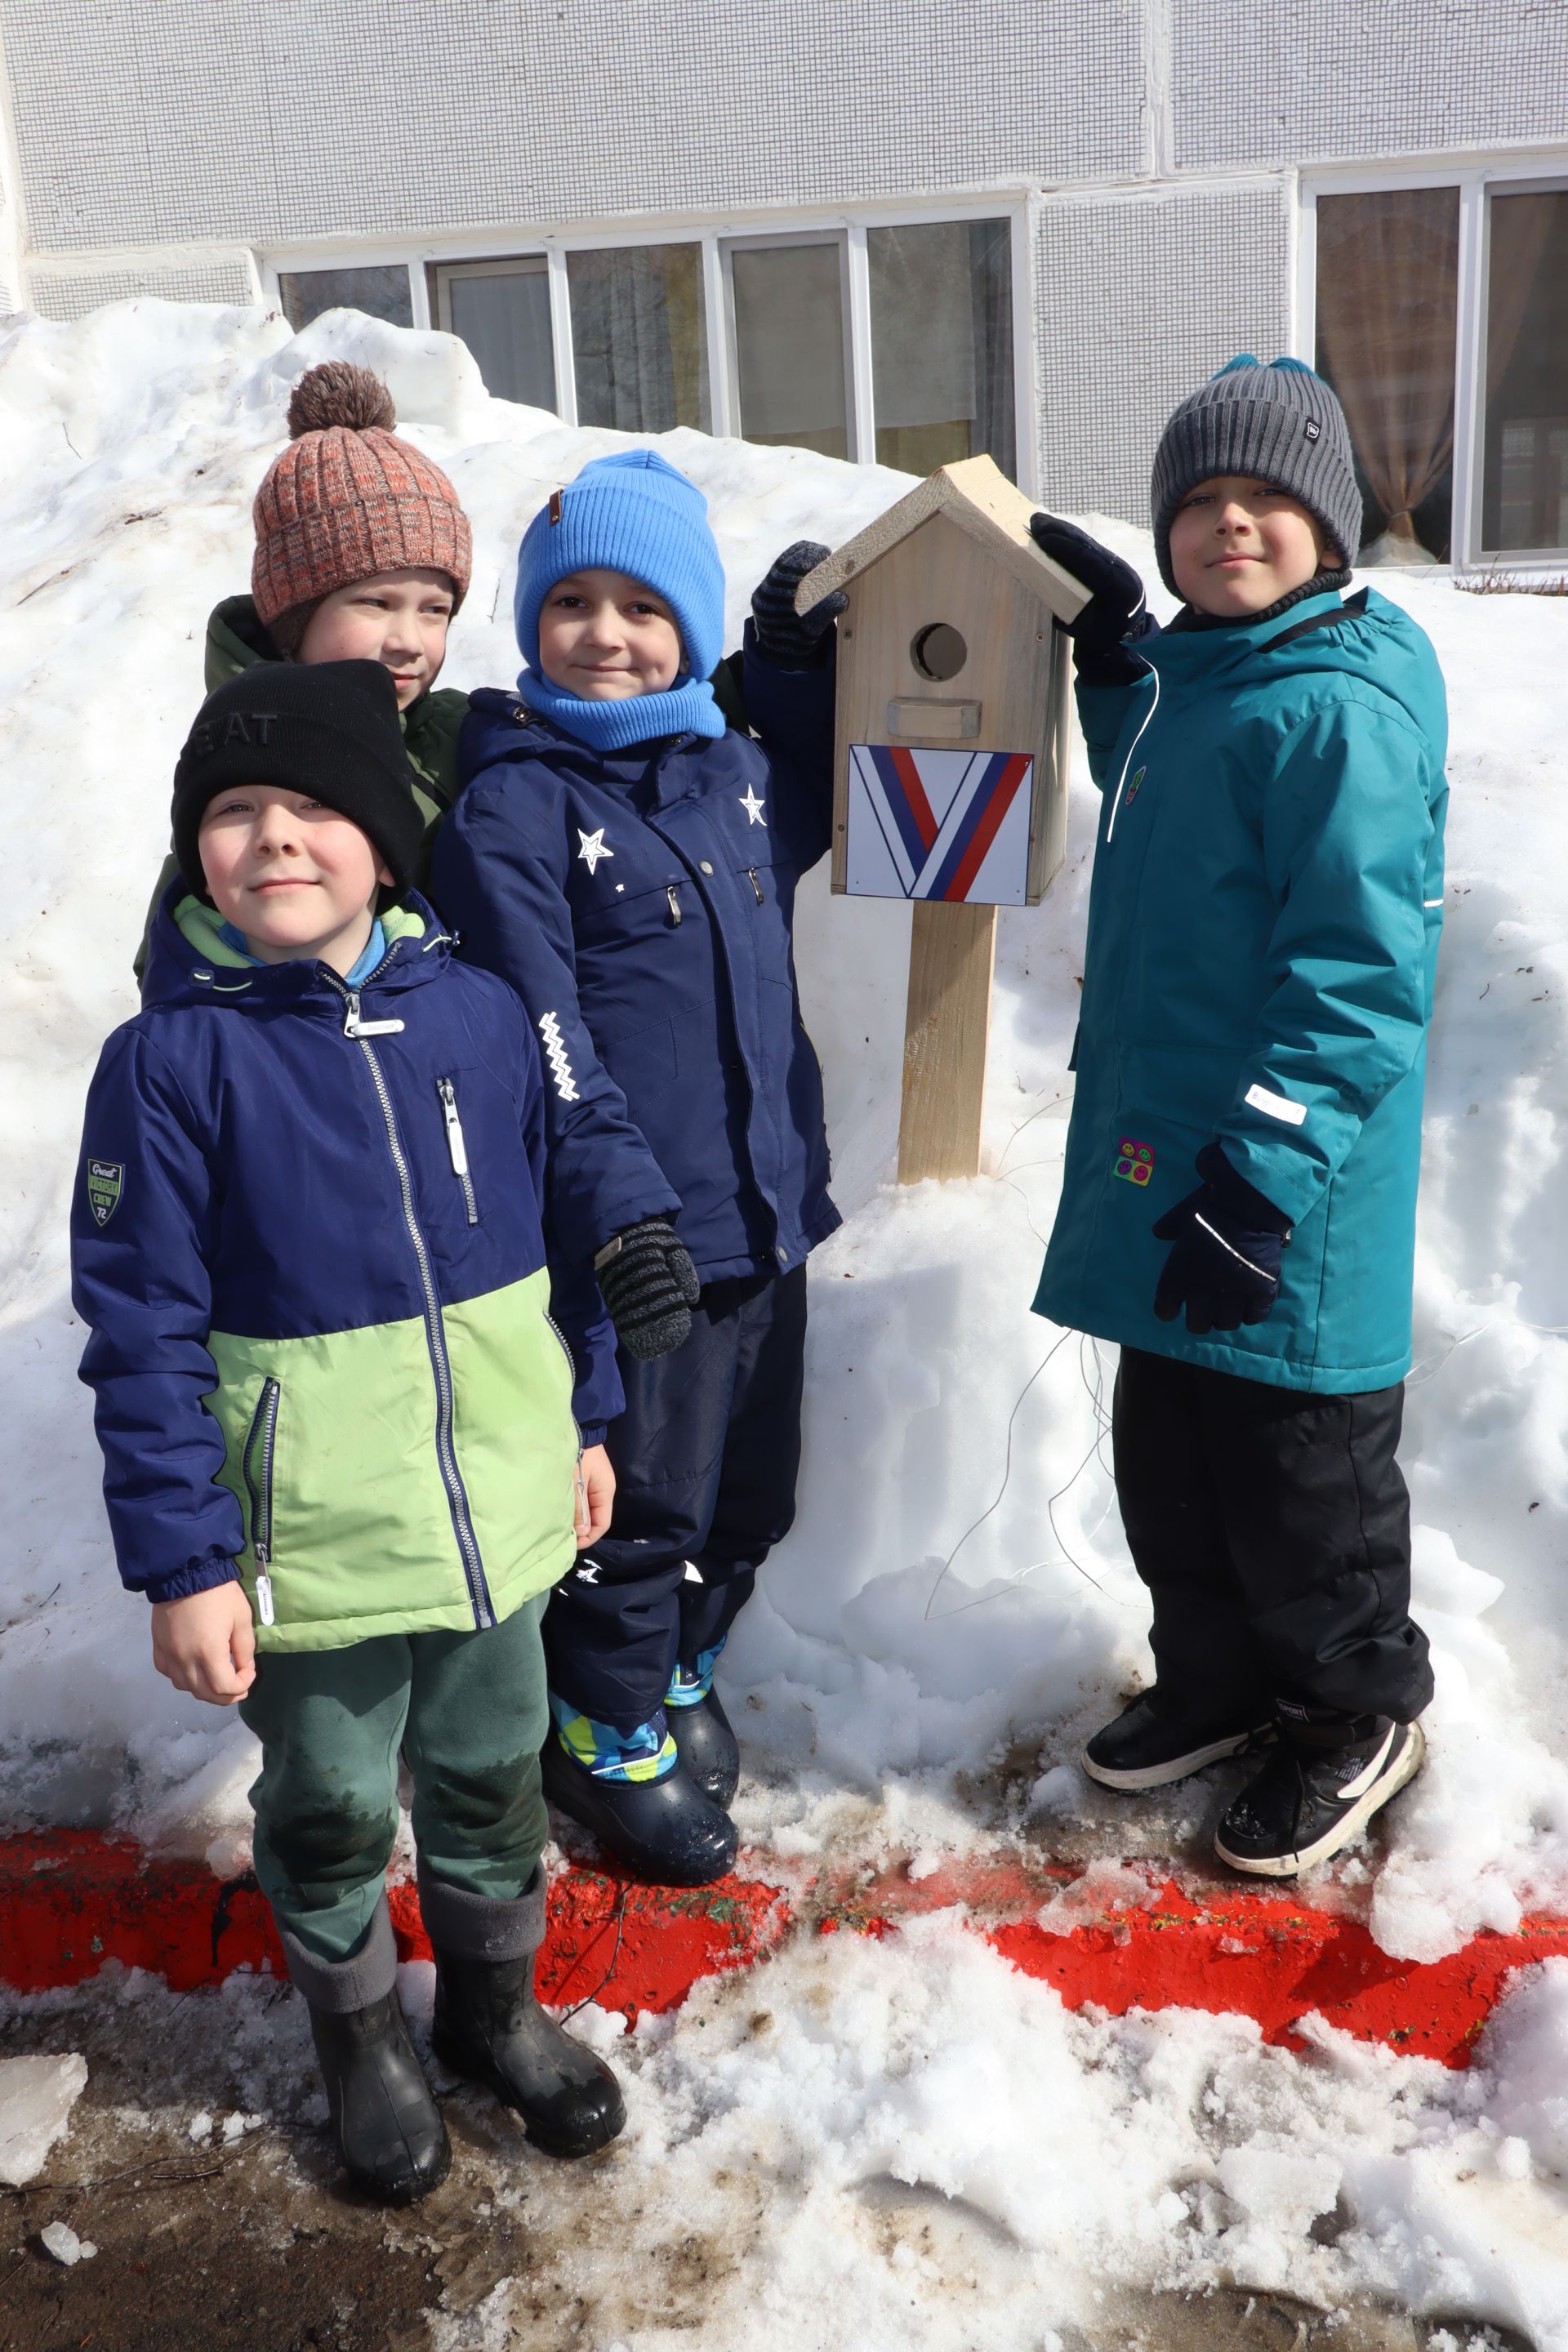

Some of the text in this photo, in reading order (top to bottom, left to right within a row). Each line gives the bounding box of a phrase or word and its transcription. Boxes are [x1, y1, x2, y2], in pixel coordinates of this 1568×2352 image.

[92, 1164, 118, 1178] Great
[91, 1178, 118, 1194] VICTORY
[97, 1207, 106, 1219] 72
